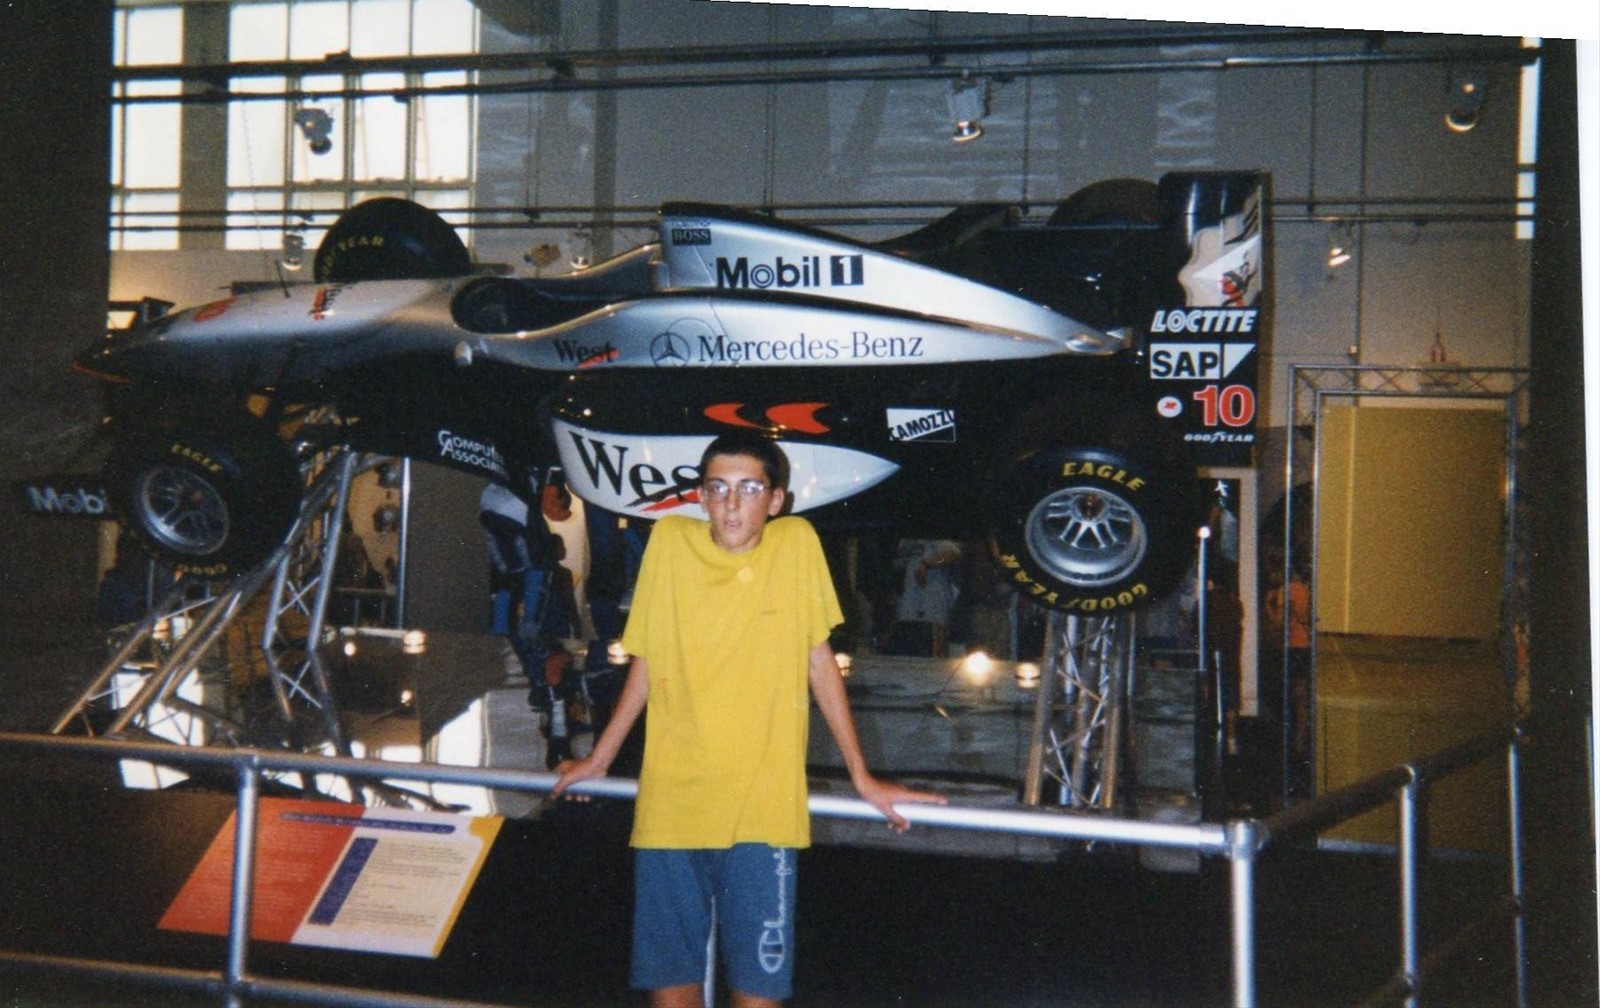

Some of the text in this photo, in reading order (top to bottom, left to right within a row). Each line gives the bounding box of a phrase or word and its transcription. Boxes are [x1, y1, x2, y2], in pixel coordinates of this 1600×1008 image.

[715, 255, 858, 289] Mobil 1
[1151, 309, 1257, 333] LOCTITE
[553, 339, 614, 363] West
[698, 332, 924, 363] Mercedes-Benz
[1151, 350, 1219, 378] SAP
[1193, 384, 1256, 427] 10
[568, 430, 702, 507] Wes
[1062, 461, 1146, 491] EAGLE
